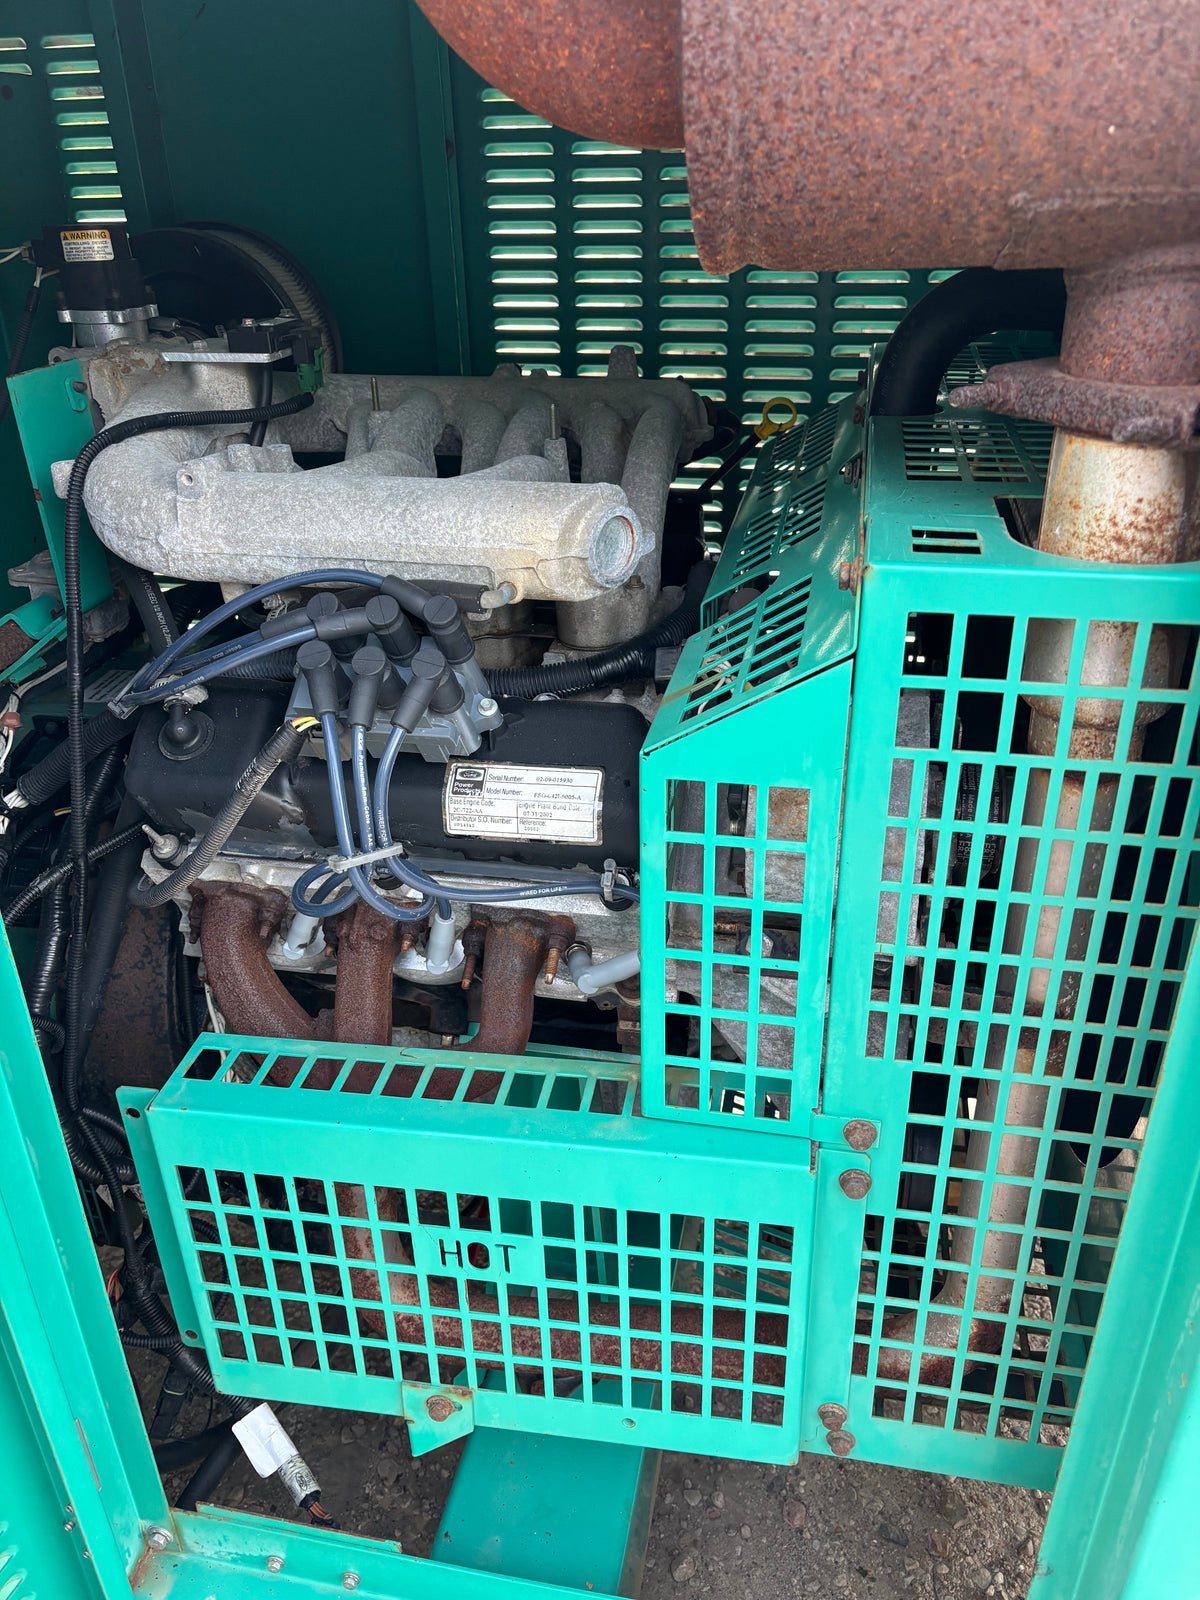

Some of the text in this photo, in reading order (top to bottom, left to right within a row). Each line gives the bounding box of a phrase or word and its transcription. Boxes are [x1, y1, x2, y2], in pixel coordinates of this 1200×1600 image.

[70, 231, 107, 240] WARNING
[358, 755, 366, 786] Premium
[486, 787, 501, 795] Model
[438, 1238, 517, 1273] HOT
